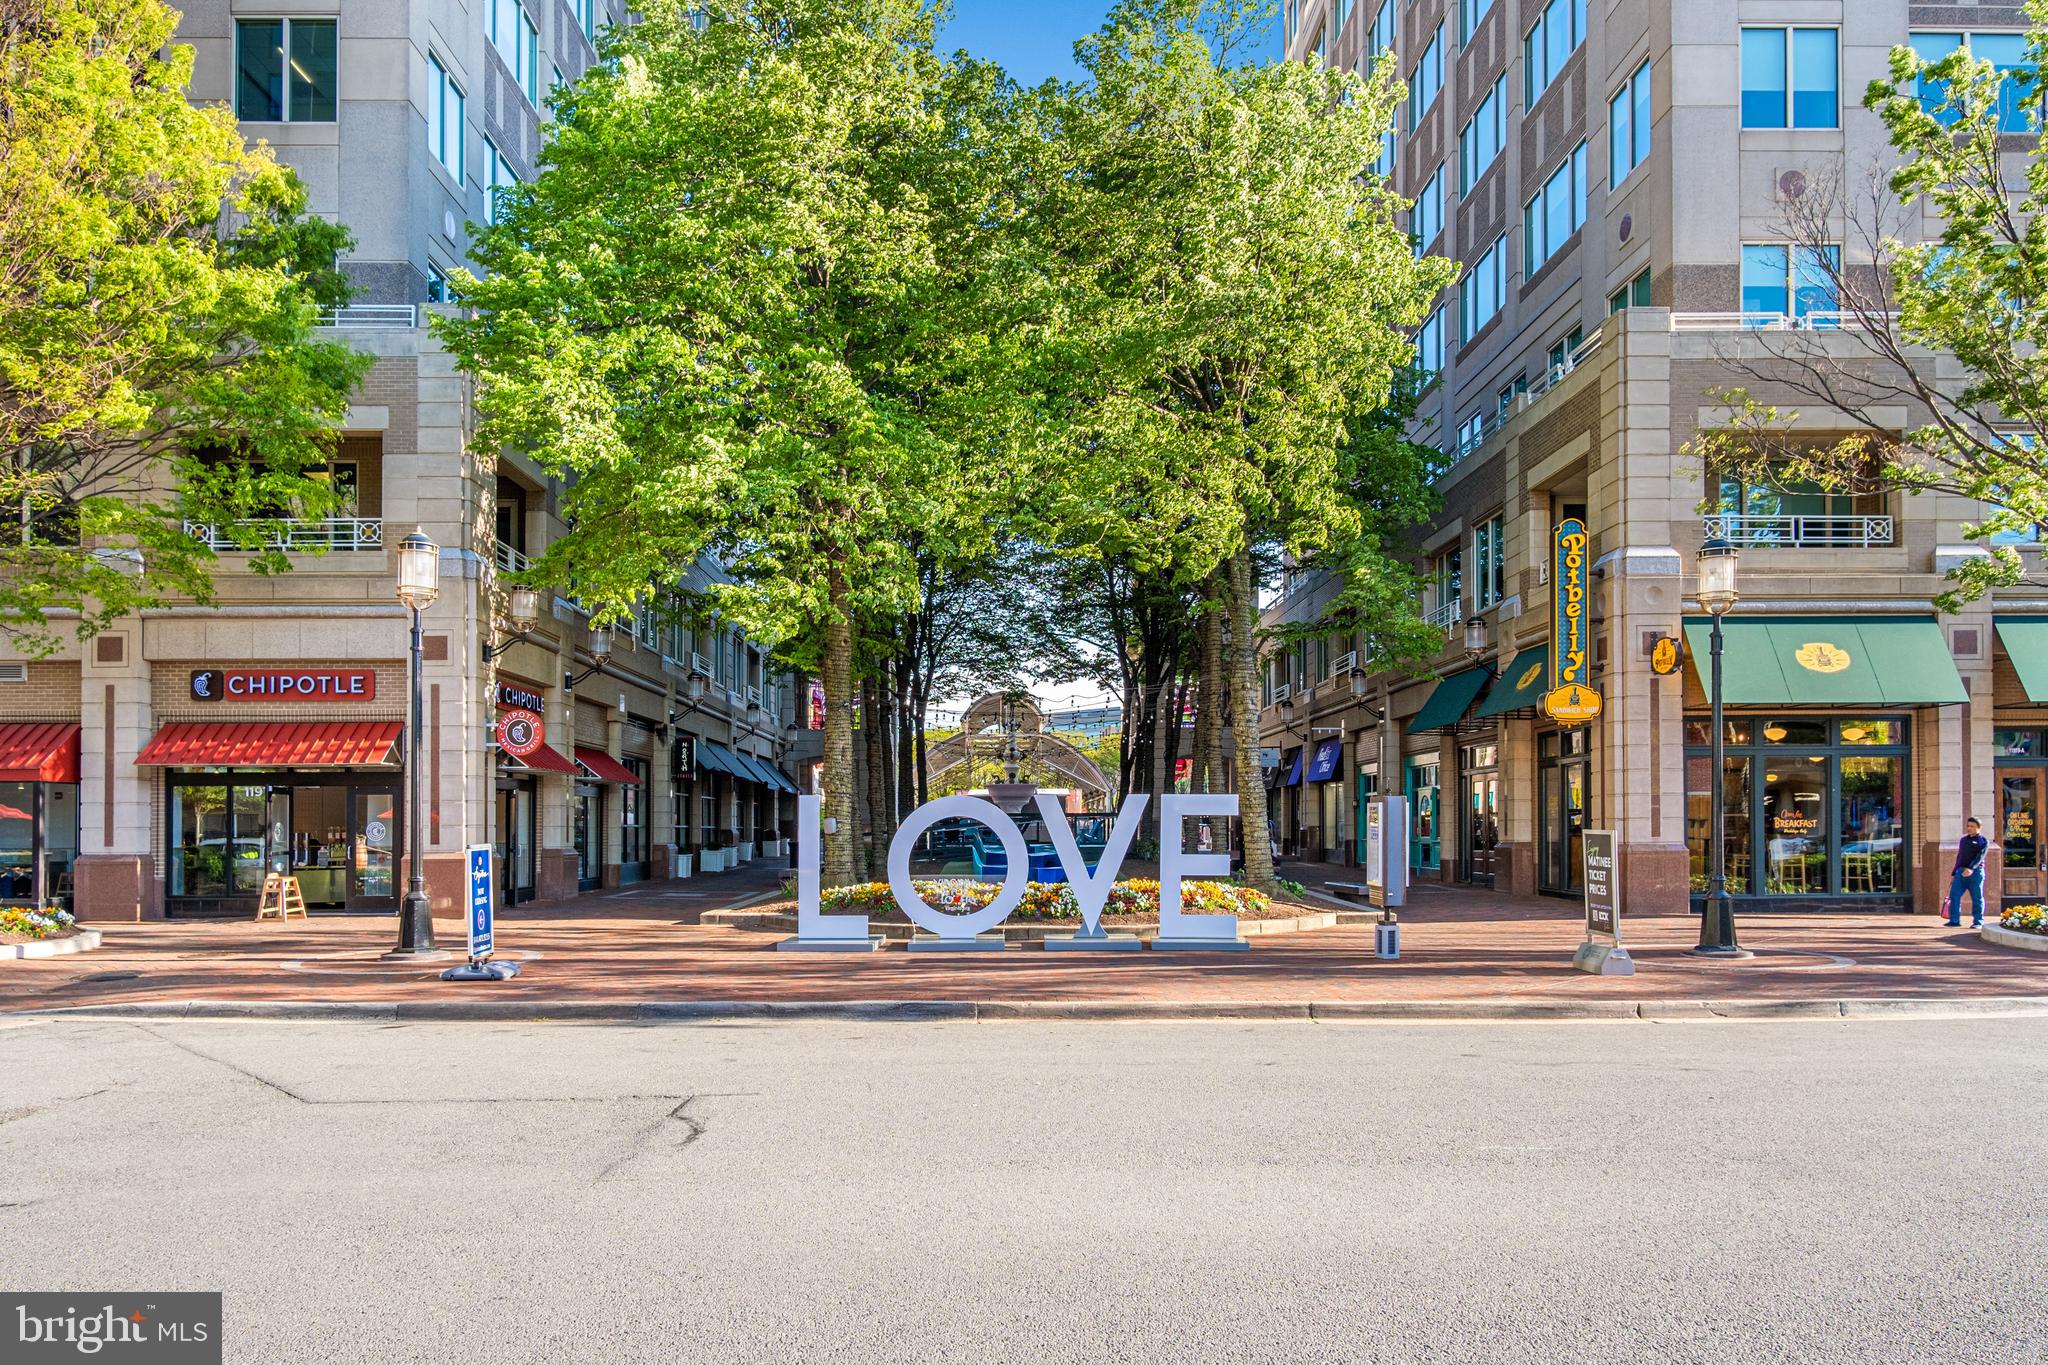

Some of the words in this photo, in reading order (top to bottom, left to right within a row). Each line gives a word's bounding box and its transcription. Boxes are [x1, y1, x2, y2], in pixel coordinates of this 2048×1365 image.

[1561, 533, 1586, 682] Potbelly
[228, 675, 365, 694] CHIPOTLE
[505, 687, 545, 713] CHIPOTLE
[499, 711, 540, 730] CHIPOTLE
[500, 738, 526, 754] MEXICAN
[526, 735, 540, 751] GRILL
[245, 786, 263, 797] 119
[1773, 817, 1818, 828] BREAKFAST
[799, 794, 1240, 938] LOVE
[1588, 856, 1611, 867] MATINEE
[1589, 869, 1606, 882] TICKET
[1589, 883, 1607, 896] PRICES
